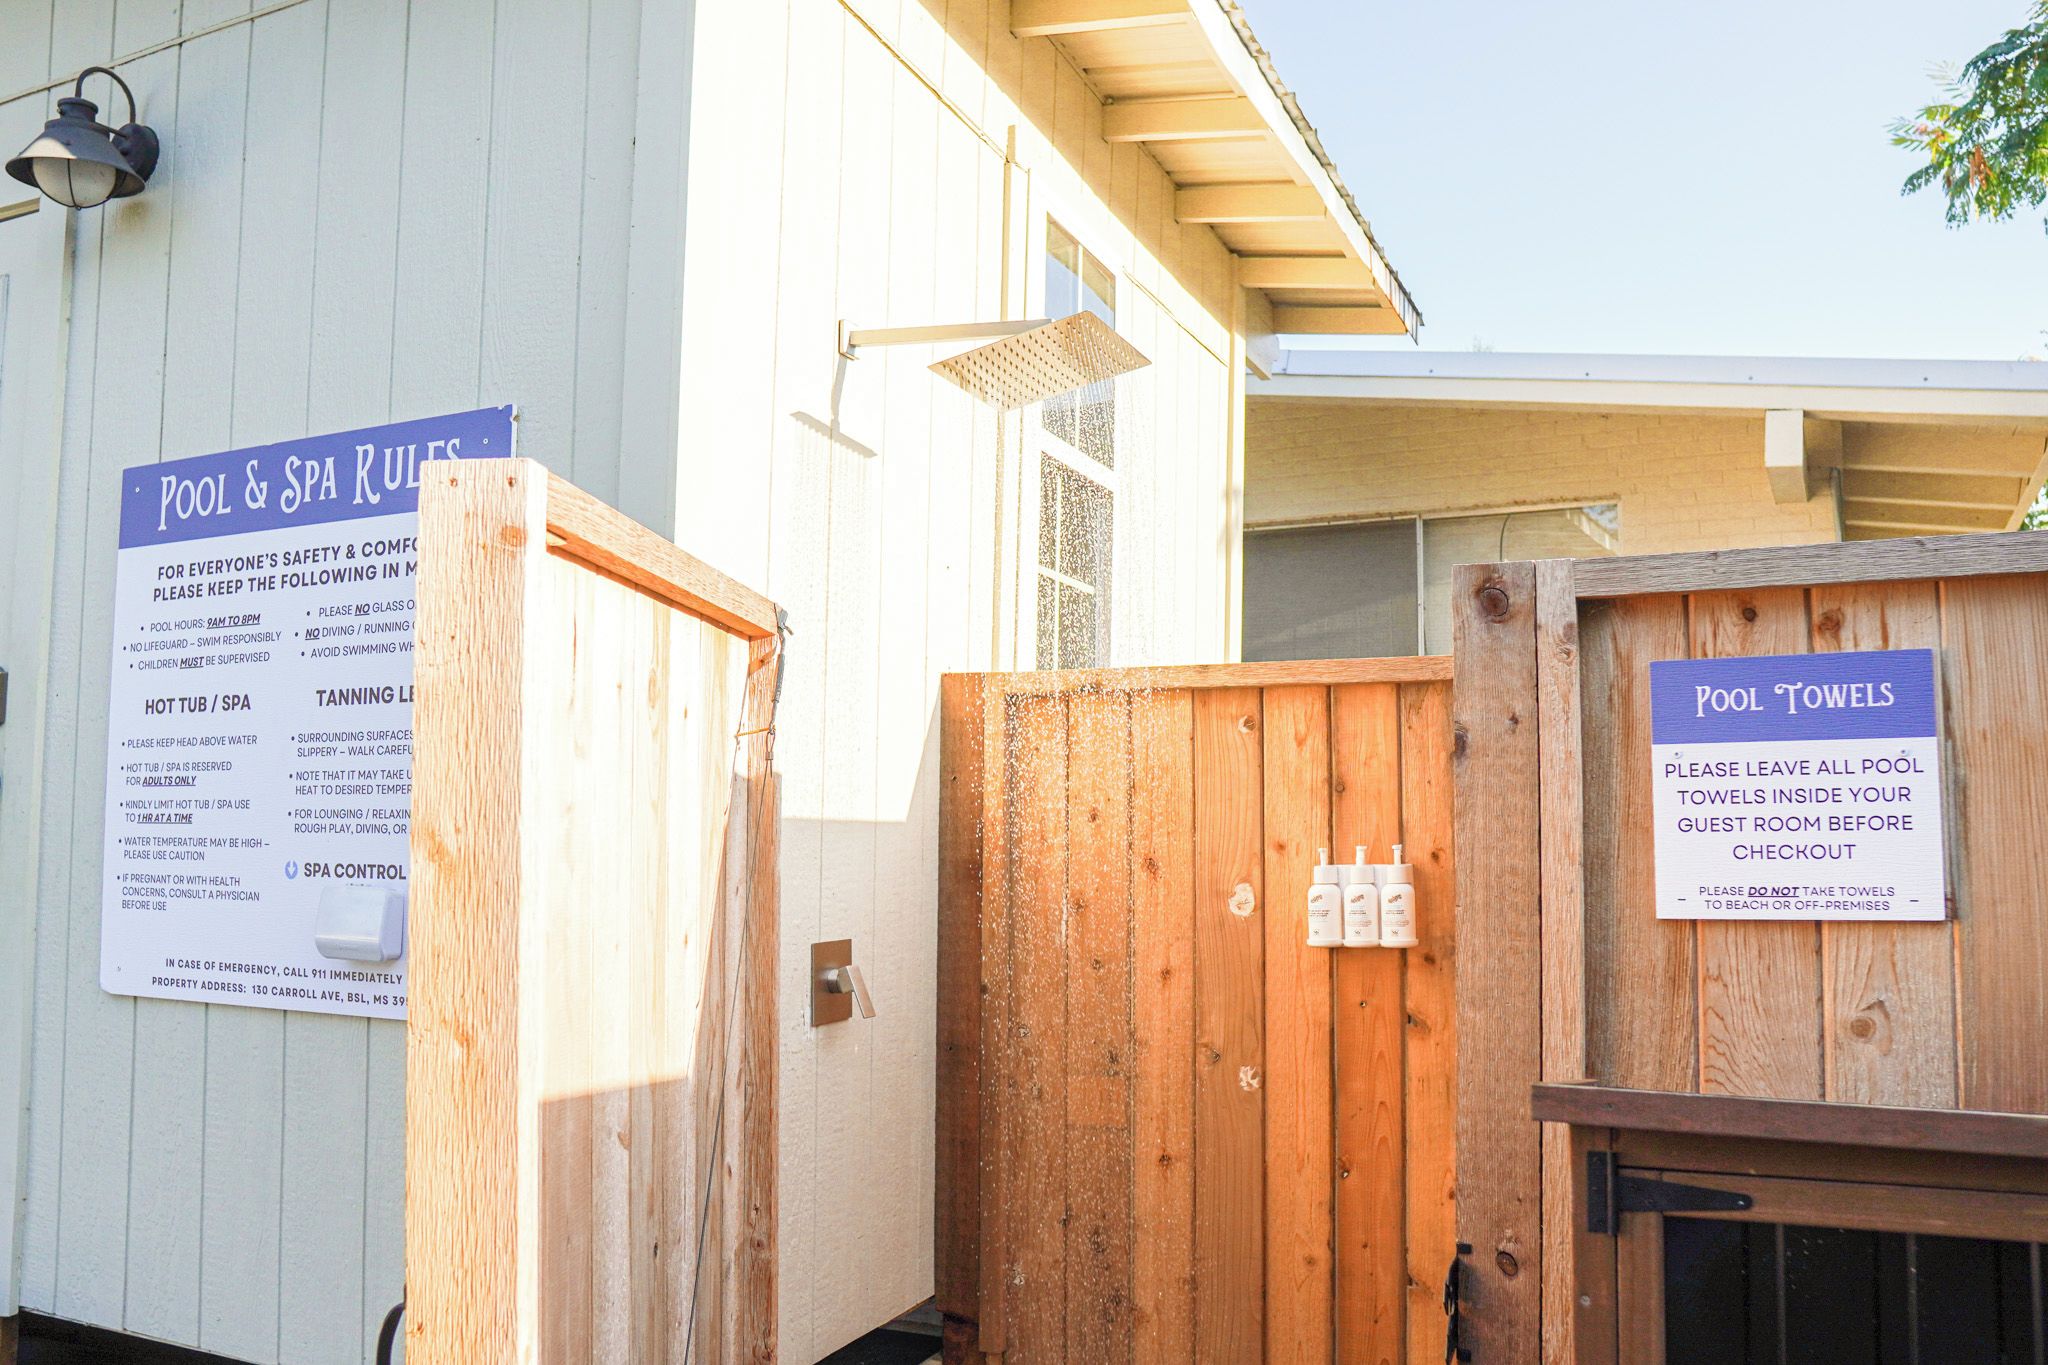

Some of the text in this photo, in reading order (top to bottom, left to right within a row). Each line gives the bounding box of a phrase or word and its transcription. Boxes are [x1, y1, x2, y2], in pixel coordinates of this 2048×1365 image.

[245, 459, 267, 510] &
[158, 564, 184, 580] FOR
[189, 553, 278, 577] EVERYONE'S
[283, 546, 341, 567] SAFETY
[346, 544, 355, 560] &
[154, 584, 203, 601] PLEASE
[208, 580, 243, 596] KEEP
[248, 577, 276, 592] THE
[281, 566, 377, 589] FOLLOWING
[383, 563, 403, 579] IN
[319, 605, 352, 618] PLEASE
[355, 604, 370, 614] NO
[372, 600, 404, 613] GLASS
[150, 614, 260, 632] POOL HOURS: 9AM TO 8PM
[305, 628, 320, 639] NO
[322, 625, 354, 637] DIVING
[357, 624, 361, 635] /
[364, 621, 409, 634] RUNNING
[130, 643, 142, 652] NO
[144, 639, 188, 651] LIFEGUARD
[197, 636, 220, 647] SWIM
[222, 631, 281, 645] RESPONSIBLY
[311, 647, 340, 658] AVOID
[343, 643, 396, 656] SWIMMING
[138, 652, 270, 670] CHILDREN MUST BE SUPERVISED
[316, 686, 394, 707] TANNING
[1696, 682, 1894, 716] POOL TOWELS
[146, 694, 250, 715] HOT TUB / SPA
[128, 736, 257, 748] PLEASE KEEP HEAD ABOVE WATER
[298, 731, 364, 743] SURROUNDING
[298, 747, 337, 757] SLIPPERY
[348, 746, 374, 756] WALK
[126, 763, 143, 772] HOT
[145, 763, 159, 772] TUB
[166, 762, 181, 772] SPA
[183, 762, 190, 771] IS
[192, 762, 232, 771] RESERVED
[1666, 758, 1924, 778] PLEASE LEAVE ALL POOL
[126, 776, 196, 786] FOR ADULTS ONLY
[296, 771, 319, 781] NOTE
[322, 771, 345, 780] THAT
[348, 771, 356, 780] IT
[358, 770, 378, 780] MAY
[381, 770, 404, 779] TAKE
[296, 785, 412, 795] HEAT TO DESIRED TEMPER
[1678, 787, 1911, 805] TOWELS INSIDE YOUR
[126, 800, 152, 809] KINDLY
[154, 800, 174, 809] LIMIT
[176, 800, 192, 809] HOT
[194, 800, 210, 809] TUB
[218, 800, 232, 809] SPA
[235, 800, 250, 809] USE
[126, 814, 135, 822] TO
[153, 814, 164, 822] AT
[166, 814, 172, 822] A
[174, 814, 192, 822] TIME
[295, 809, 312, 819] FOR
[314, 809, 363, 819] LOUNGING
[372, 809, 410, 819] RELAXIN
[294, 824, 407, 835] ROUGH PLAY, DIVING, OR
[1678, 816, 1912, 832] GUEST ROOM BEFORE
[124, 837, 150, 846] WATER
[152, 837, 207, 847] TEMPERATURE
[210, 838, 227, 847] MAY
[229, 838, 239, 847] BE
[242, 838, 262, 848] HIGH
[124, 850, 204, 860] PLEASE USE CAUTION
[1733, 844, 1856, 859] CHECKOUT
[304, 863, 406, 880] SPA CONTROL
[122, 874, 240, 886] IF PREGNANT OR WITH HEALTH
[122, 887, 259, 901] CONCERNS, CONSULT A PHYSICIAN
[1700, 887, 1894, 896] PLEASE DO NOT TAKE TOWELS
[122, 900, 166, 911] BEFORE USE
[1705, 901, 1890, 910] TO BEACH OR OFF-PREMISES
[166, 958, 402, 985] IN CASE OF EMERGENCY, CALL 911 IMMEDIATELY
[152, 977, 198, 989] PROPERTY
[201, 980, 246, 993] ADDRESS:
[252, 984, 268, 995] 130
[272, 986, 317, 999] CARROLL
[321, 990, 343, 1002] AVE,
[348, 992, 369, 1004] BSL,
[374, 994, 389, 1005] MS
